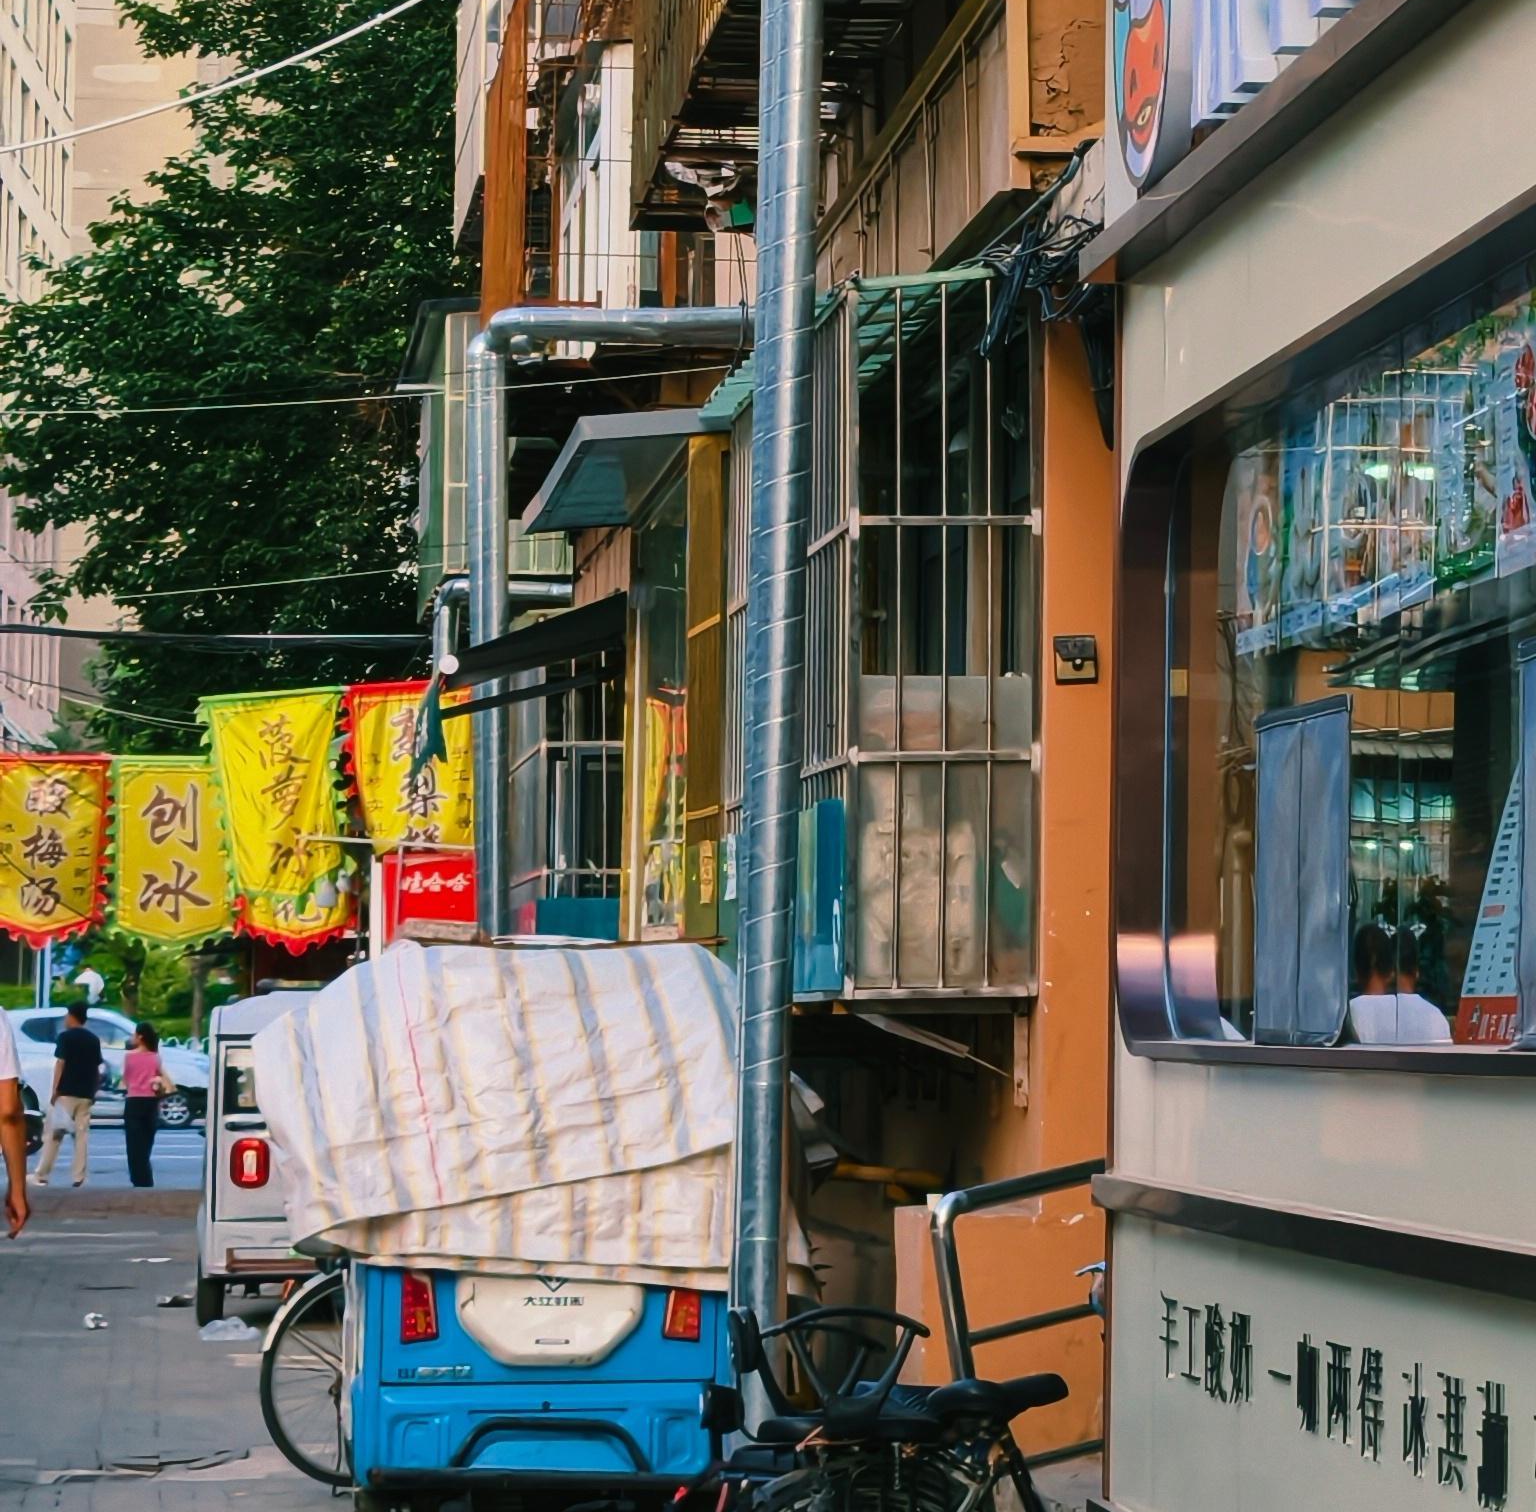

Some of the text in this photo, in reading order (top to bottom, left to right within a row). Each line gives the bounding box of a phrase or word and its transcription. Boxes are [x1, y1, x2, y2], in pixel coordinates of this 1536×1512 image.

[20, 777, 71, 918] 酸梅汤
[139, 782, 212, 924] 刨冰
[1158, 1290, 1253, 1405] 手工酸奶
